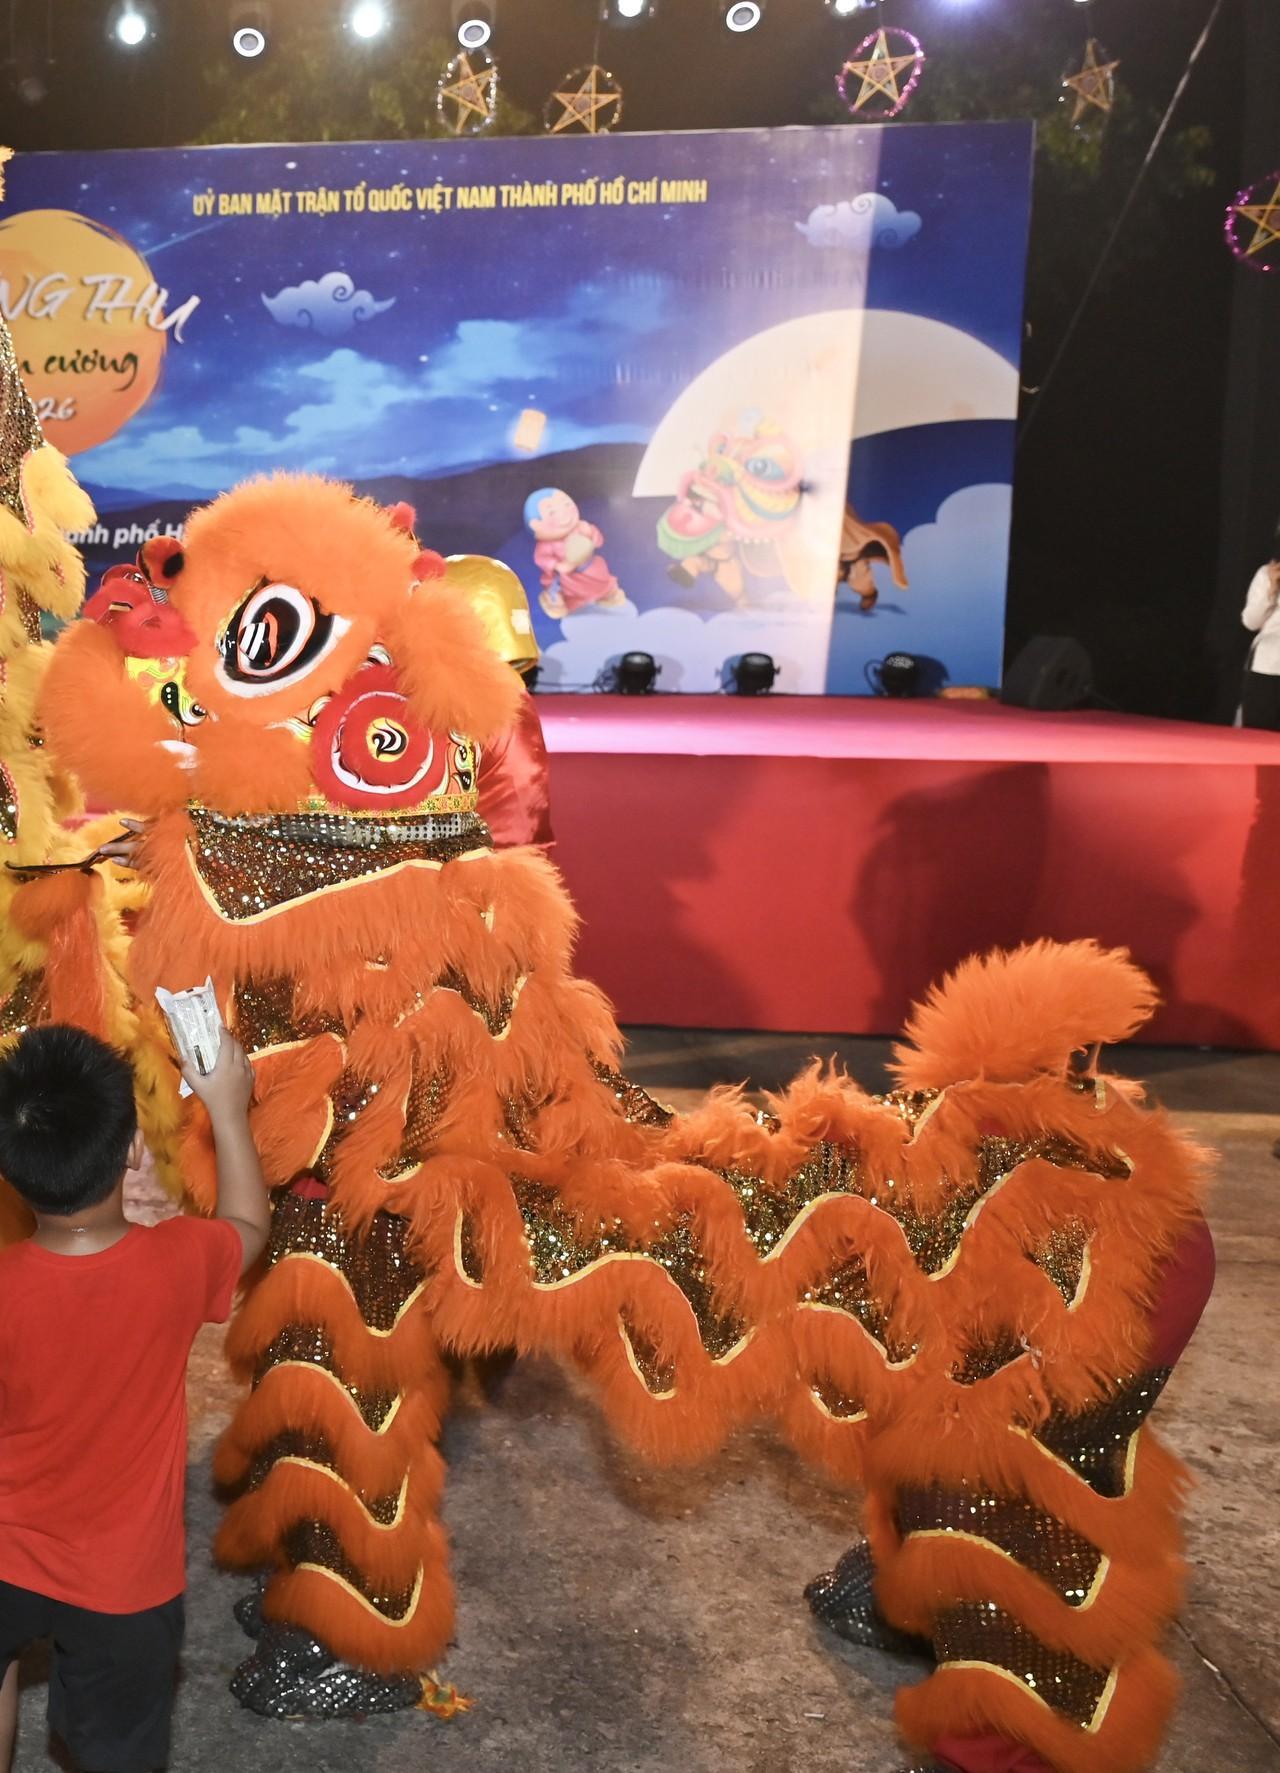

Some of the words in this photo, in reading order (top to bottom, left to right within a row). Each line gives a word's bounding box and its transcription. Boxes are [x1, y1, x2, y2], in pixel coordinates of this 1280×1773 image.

[218, 193, 253, 216] BAN
[296, 186, 340, 217] TRẬN
[344, 180, 368, 213] TỔ
[368, 182, 414, 213] QUỐC
[415, 183, 455, 214] VIỆT
[456, 186, 497, 209] NAM
[499, 180, 558, 208] THÀNH
[561, 175, 600, 206] PHỐ
[627, 176, 659, 205] CHÍ
[660, 179, 708, 204] MINH
[81, 273, 201, 344] THU
